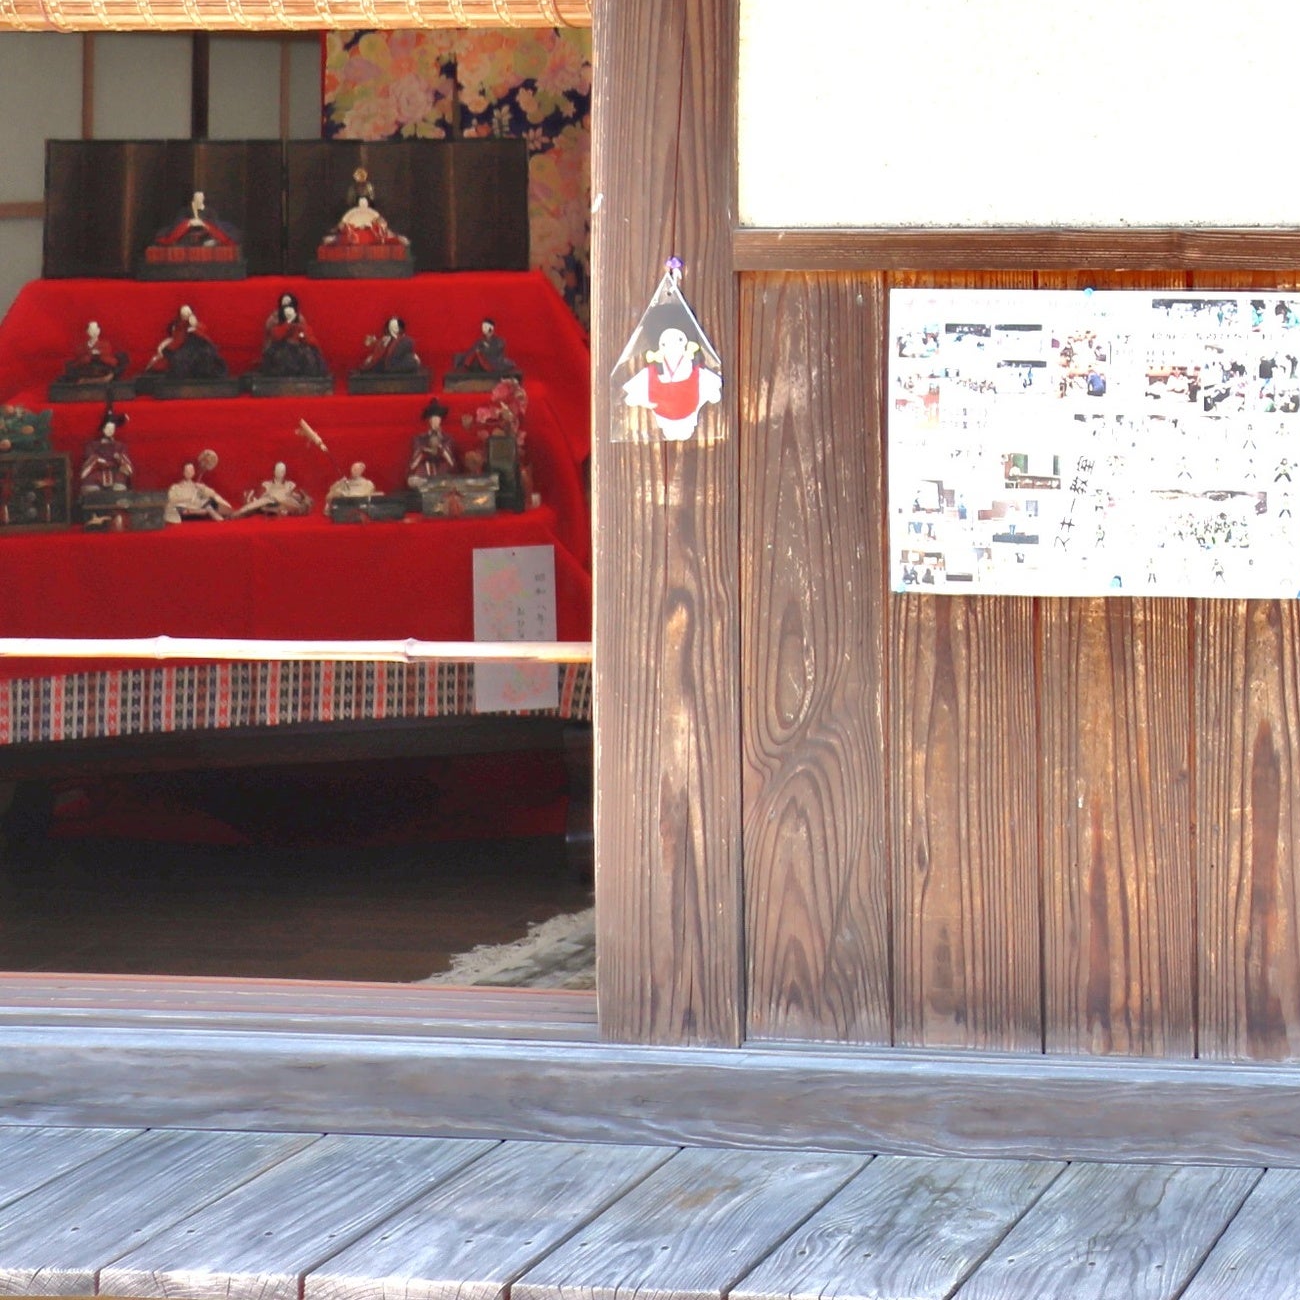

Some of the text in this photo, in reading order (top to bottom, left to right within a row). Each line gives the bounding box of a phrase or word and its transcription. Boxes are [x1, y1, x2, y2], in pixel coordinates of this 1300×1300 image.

[1053, 455, 1095, 552] スキー教室
